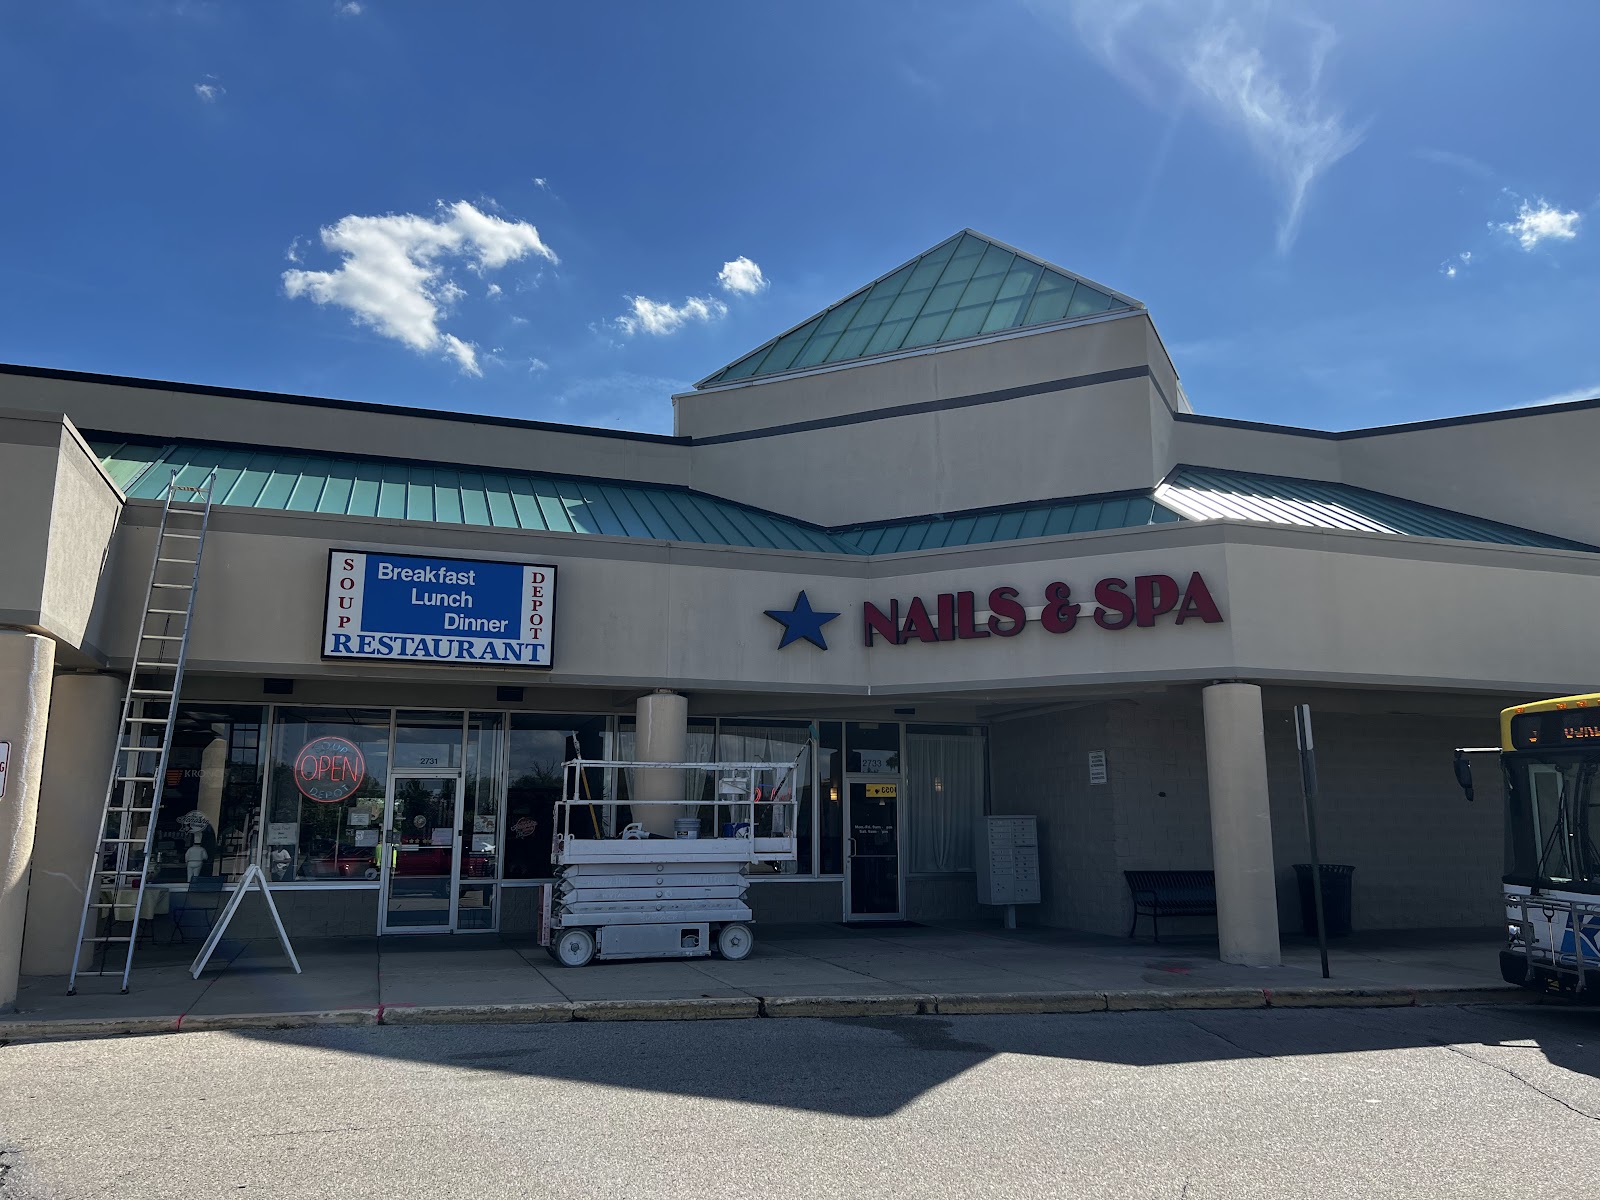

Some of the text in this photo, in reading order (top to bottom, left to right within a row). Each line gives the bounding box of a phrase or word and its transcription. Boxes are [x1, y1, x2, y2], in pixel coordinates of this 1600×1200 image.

[377, 562, 476, 586] Breakfast
[337, 558, 354, 628] SOUP
[411, 588, 473, 608] Lunch
[529, 571, 545, 640] DEPOT
[863, 571, 1225, 648] NAILS & SPA
[444, 613, 508, 633] Dinner
[330, 633, 545, 662] RESTAURANT
[300, 754, 359, 782] OPEN
[420, 757, 438, 765] 2731
[862, 759, 882, 767] 2733
[309, 784, 349, 799] DEPOT
